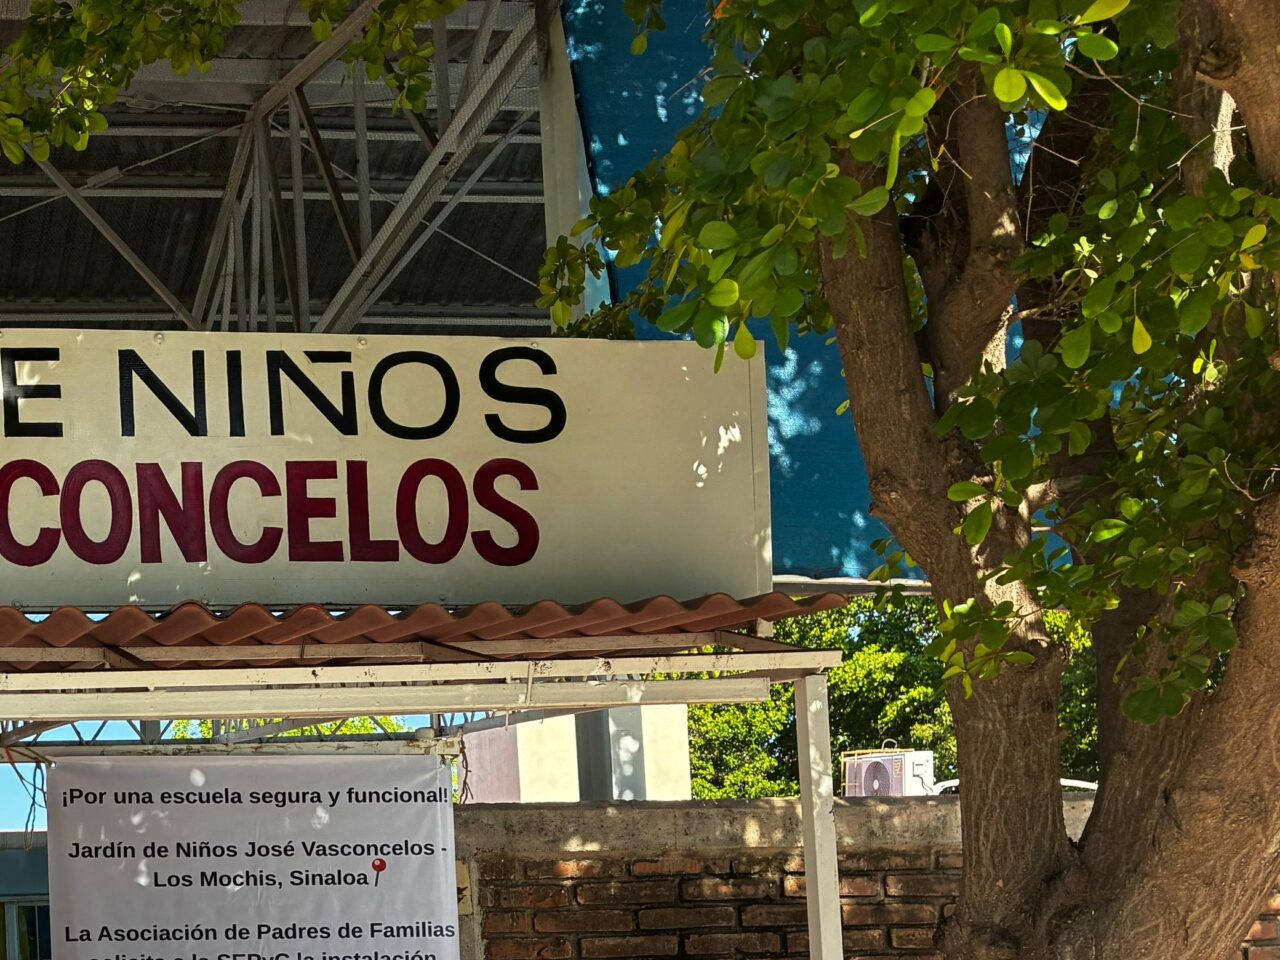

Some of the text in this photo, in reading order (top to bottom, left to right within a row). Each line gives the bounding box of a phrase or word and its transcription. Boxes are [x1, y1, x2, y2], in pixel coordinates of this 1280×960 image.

[120, 345, 567, 444] NIÑOS
[62, 787, 448, 807] ¡Por una escuela segura y funcional!
[68, 842, 135, 858] Jardín
[143, 842, 169, 857] de
[176, 841, 237, 857] Niños
[244, 840, 295, 857] José
[302, 840, 435, 856] Vasconcelos
[153, 869, 369, 889] Los Mochis, Sinaloa
[65, 921, 455, 942] La Asociación de Padres de Familias
